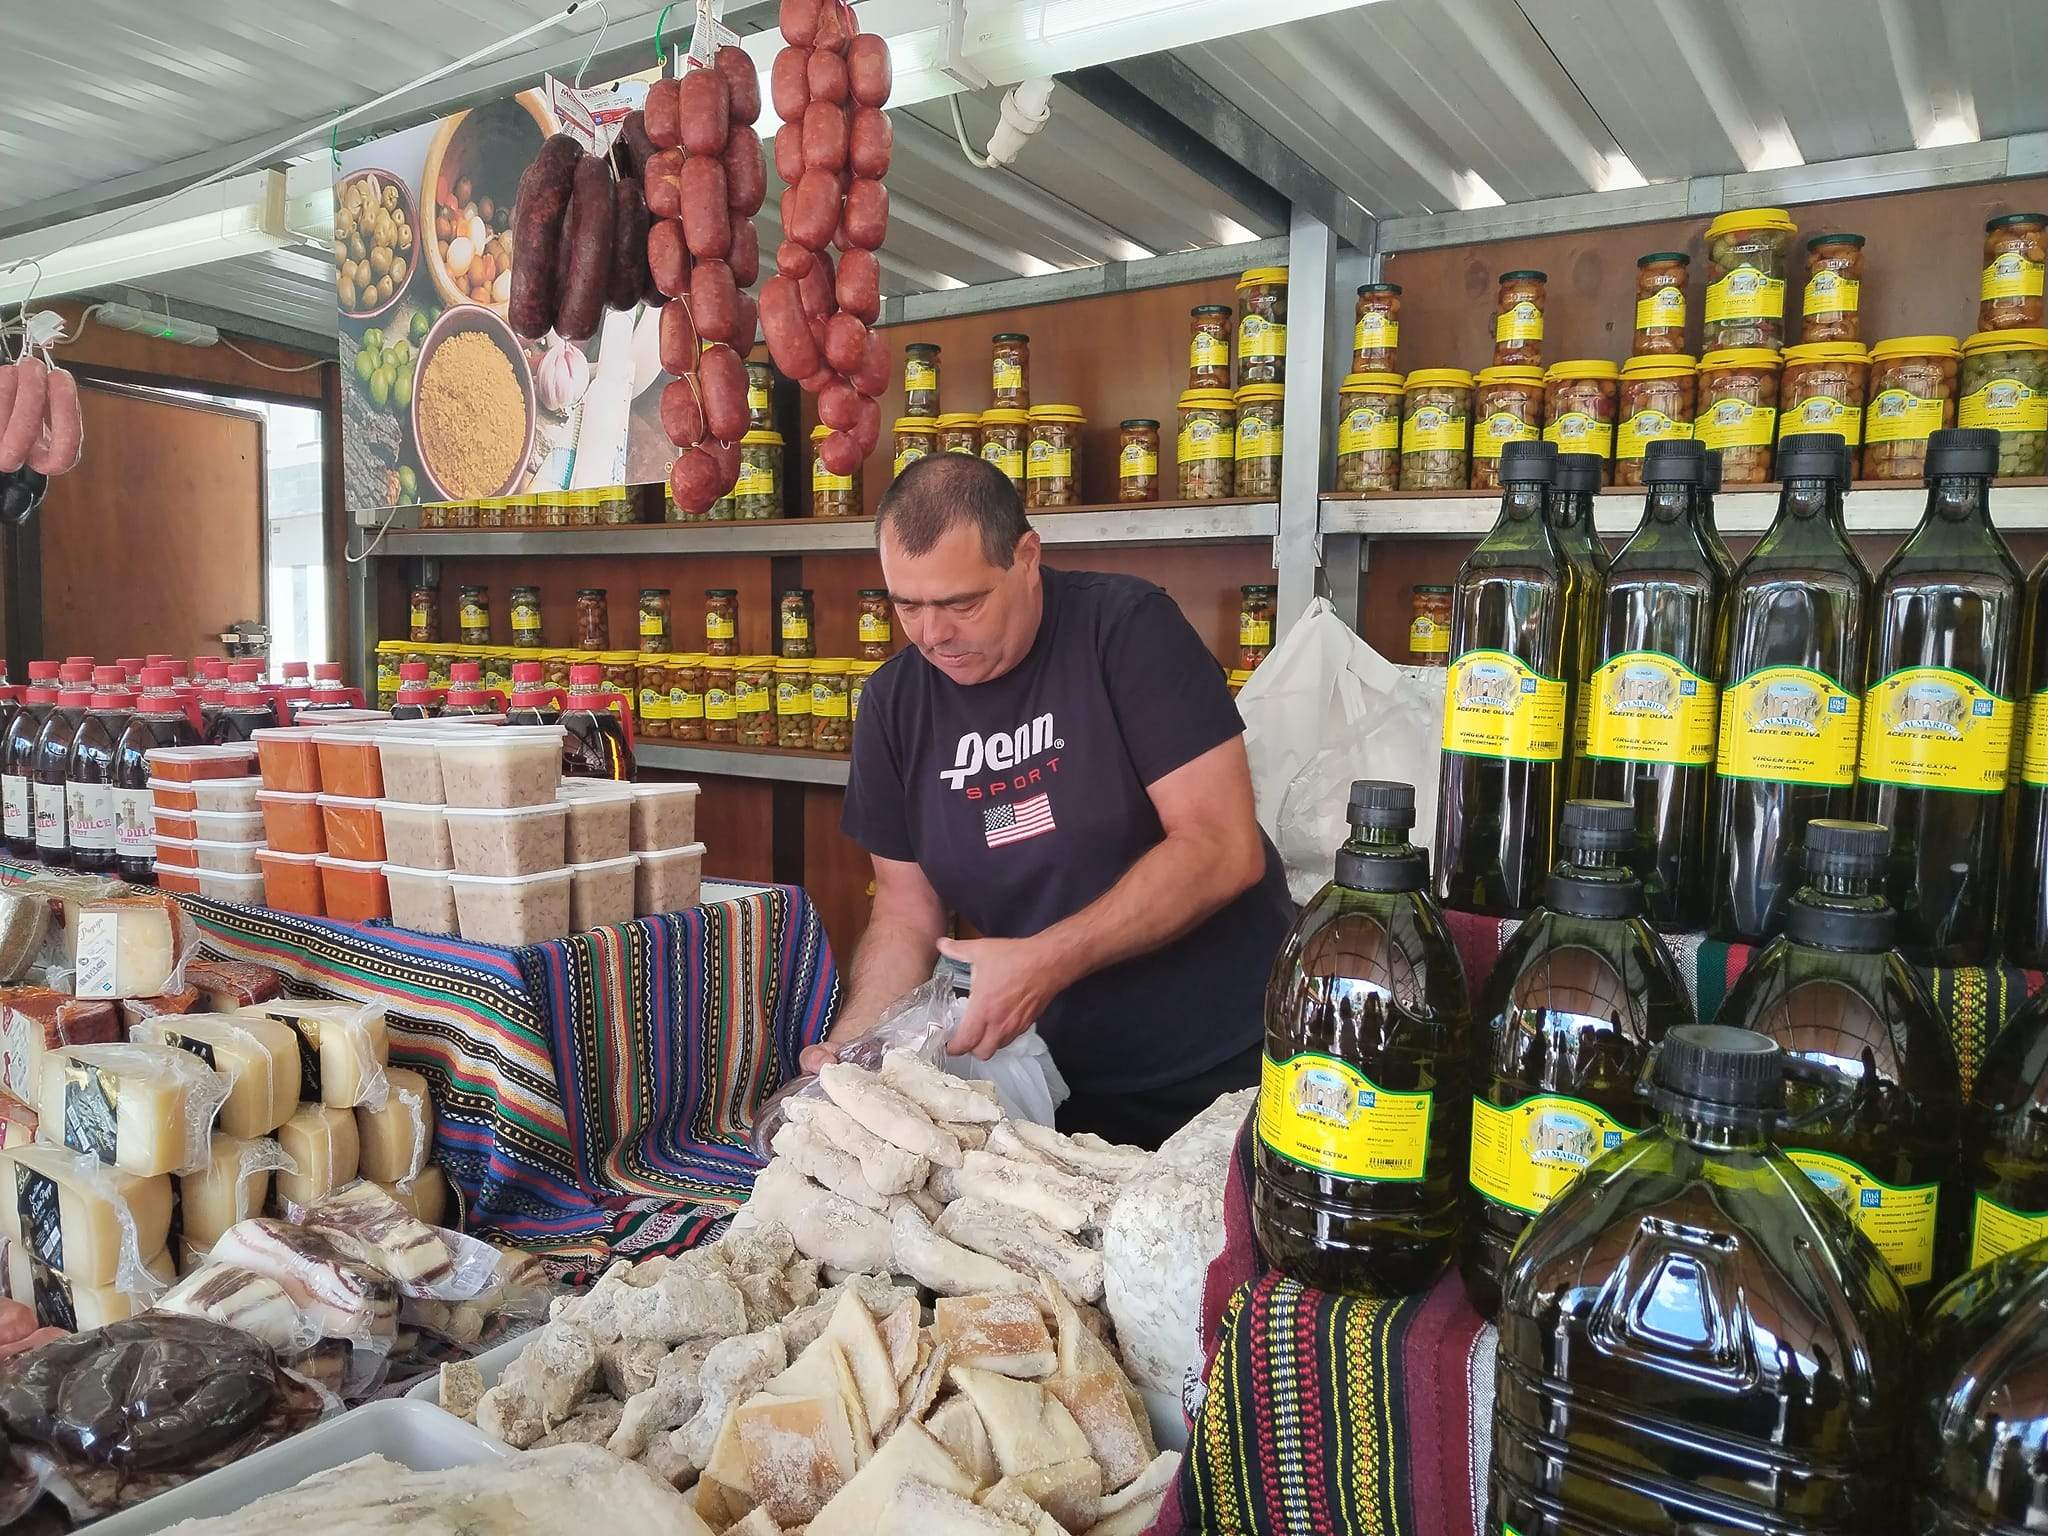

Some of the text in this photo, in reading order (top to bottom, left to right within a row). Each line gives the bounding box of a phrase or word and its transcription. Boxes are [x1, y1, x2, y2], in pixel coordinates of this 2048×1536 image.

[1622, 700, 1663, 710] ALMARIO
[1764, 718, 1810, 728] ALMARIO
[1904, 722, 1952, 732] ALMARIO
[1794, 730, 1821, 738] OLIVA
[1936, 734, 1964, 742] OLIVA
[1752, 755, 1784, 763] VIRGEN
[1890, 760, 1924, 768] VIRGEN
[966, 757, 1060, 800] SPORT
[76, 818, 112, 830] DULCE
[126, 827, 156, 838] DULC
[1296, 1113, 1316, 1124] ACEITE
[1328, 1122, 1350, 1131] OLIVA
[1296, 1141, 1321, 1154] VIRGEN
[1322, 1150, 1348, 1160] EXTRA
[1540, 1150, 1586, 1164] ALMARIO
[1531, 1160, 1556, 1170] ACEITE
